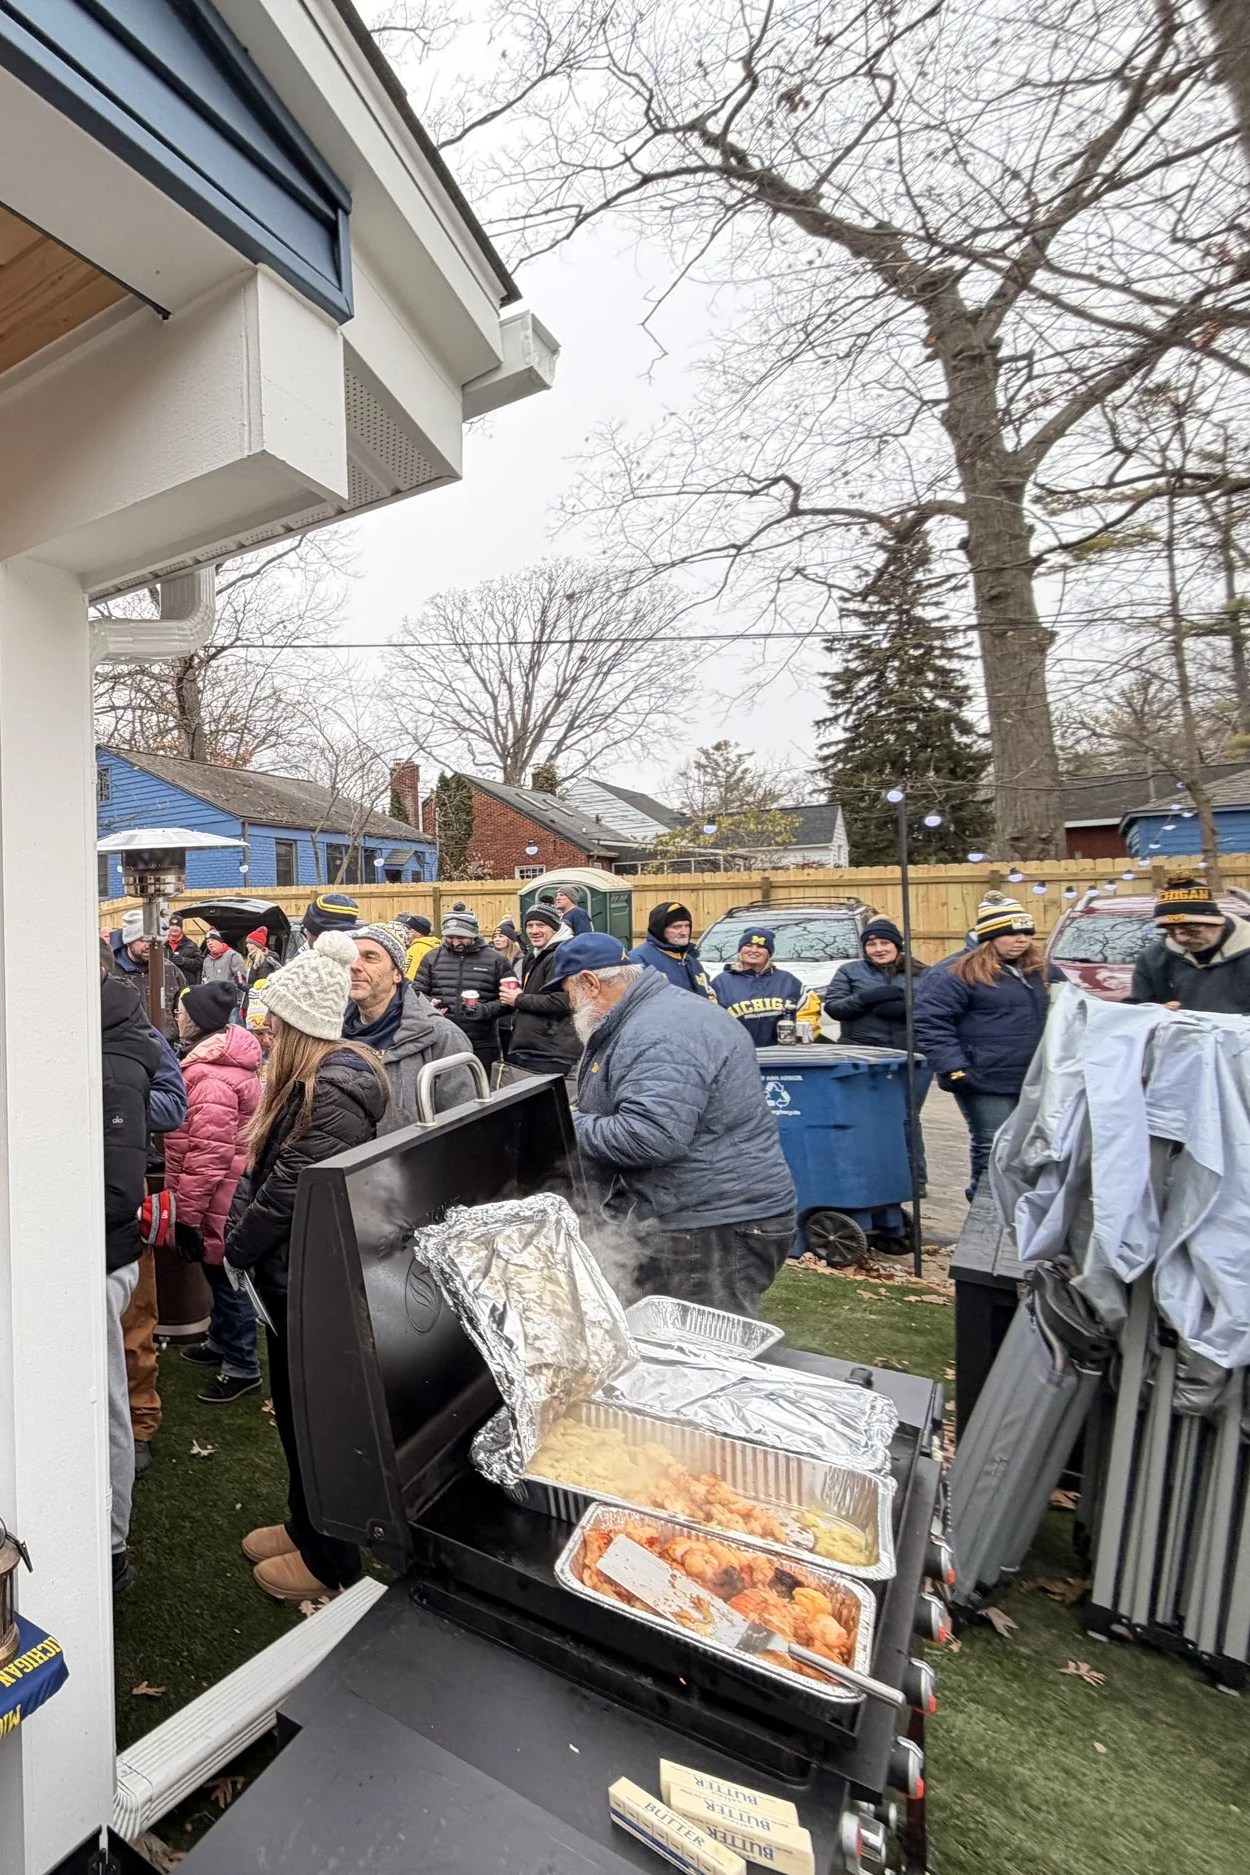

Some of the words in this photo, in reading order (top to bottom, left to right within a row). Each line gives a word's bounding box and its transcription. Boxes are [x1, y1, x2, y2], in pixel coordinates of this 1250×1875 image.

[693, 1776, 758, 1806] BUTTER
[644, 1802, 705, 1848] BUTTER
[704, 1800, 772, 1832] BUTTER
[707, 1826, 775, 1861] BUTTER
